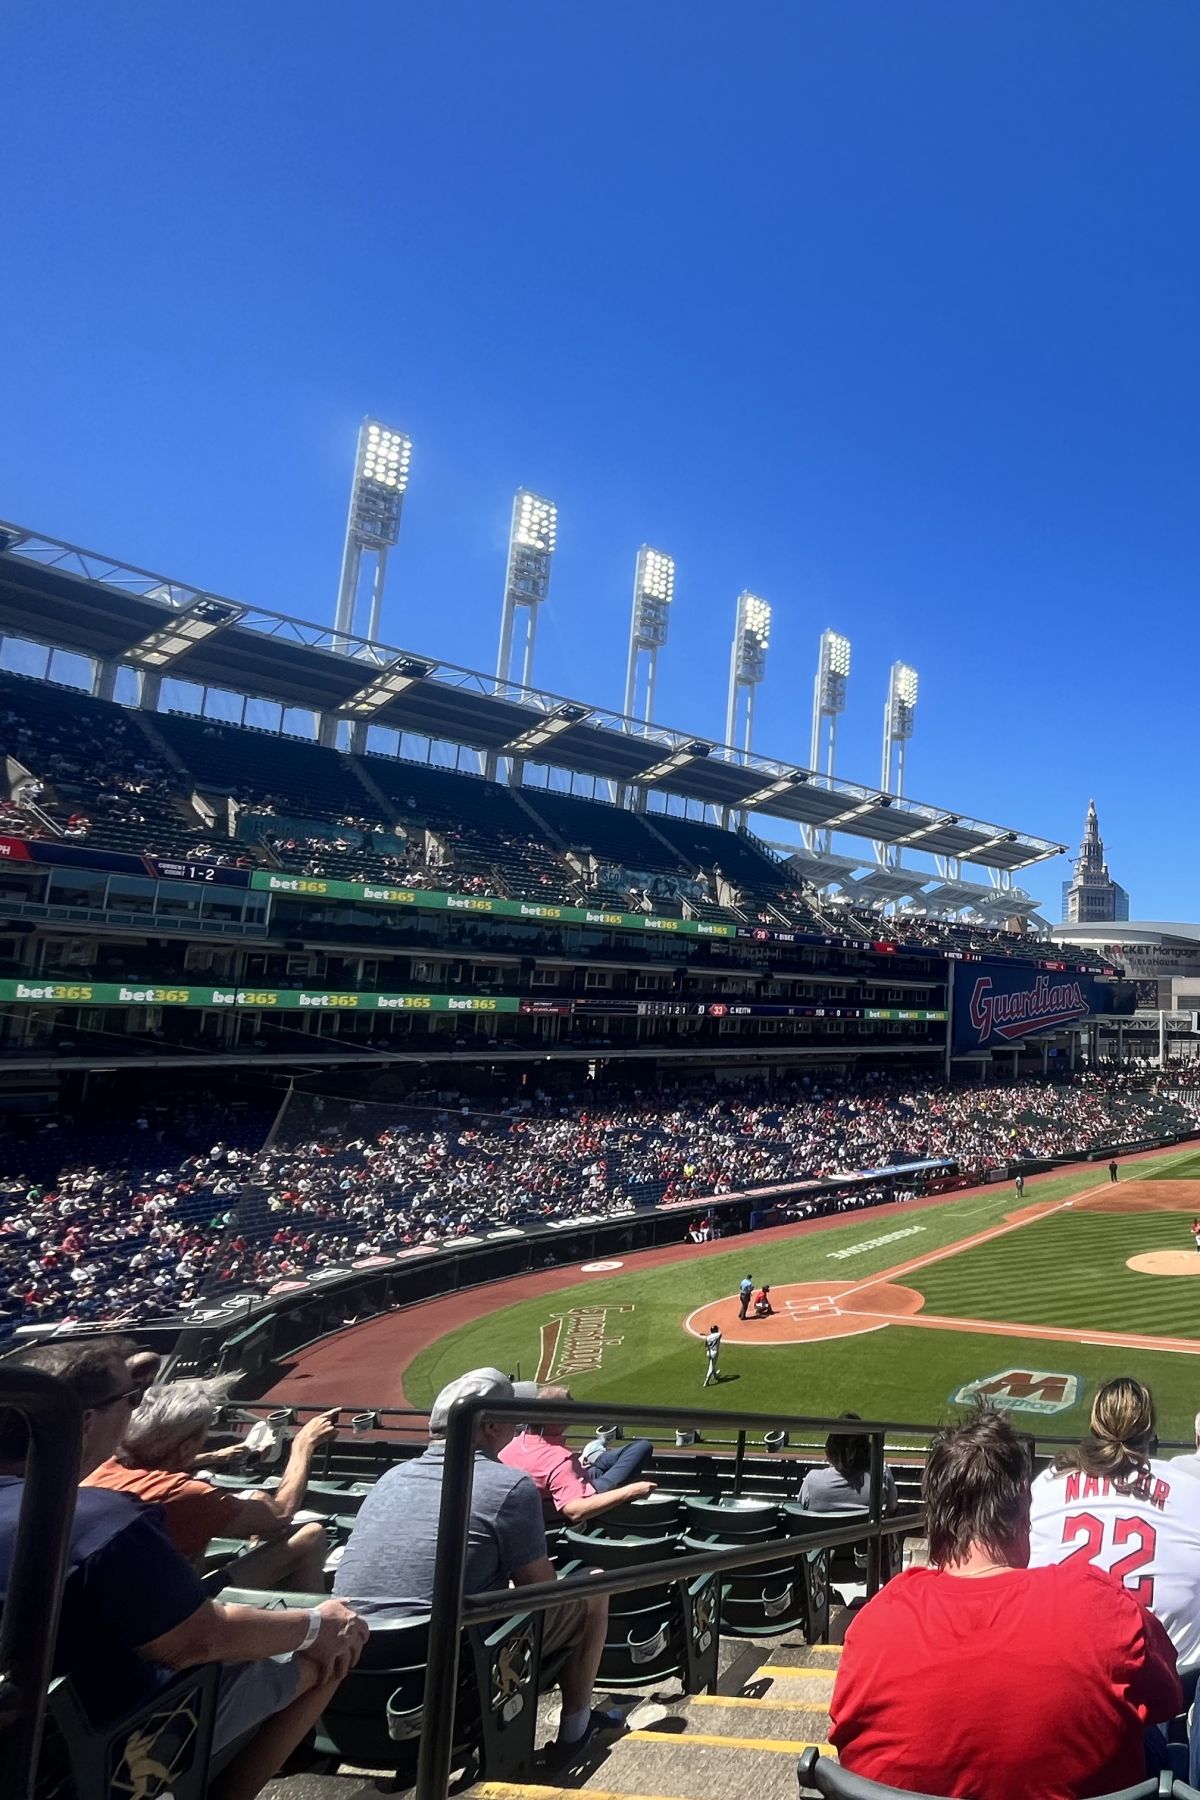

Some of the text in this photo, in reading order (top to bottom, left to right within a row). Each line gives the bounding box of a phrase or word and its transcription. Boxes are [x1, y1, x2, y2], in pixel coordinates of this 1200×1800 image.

[270, 877, 327, 894] bet365
[363, 887, 415, 903] bet365
[447, 897, 492, 911] bet365
[520, 905, 561, 918] bet365
[586, 912, 623, 925] bet365
[645, 918, 678, 930] bet365
[697, 924, 728, 935] bet365
[1103, 945, 1150, 955] ROCKET
[16, 984, 92, 1000] bet365
[119, 988, 190, 1002] bet365
[212, 991, 277, 1006] bet365
[299, 993, 358, 1008] bet365
[378, 996, 431, 1009] bet365
[448, 997, 497, 1010] bet365
[713, 1006, 723, 1015] 33
[970, 975, 1090, 1044] Guardians
[1059, 1511, 1157, 1609] 22
